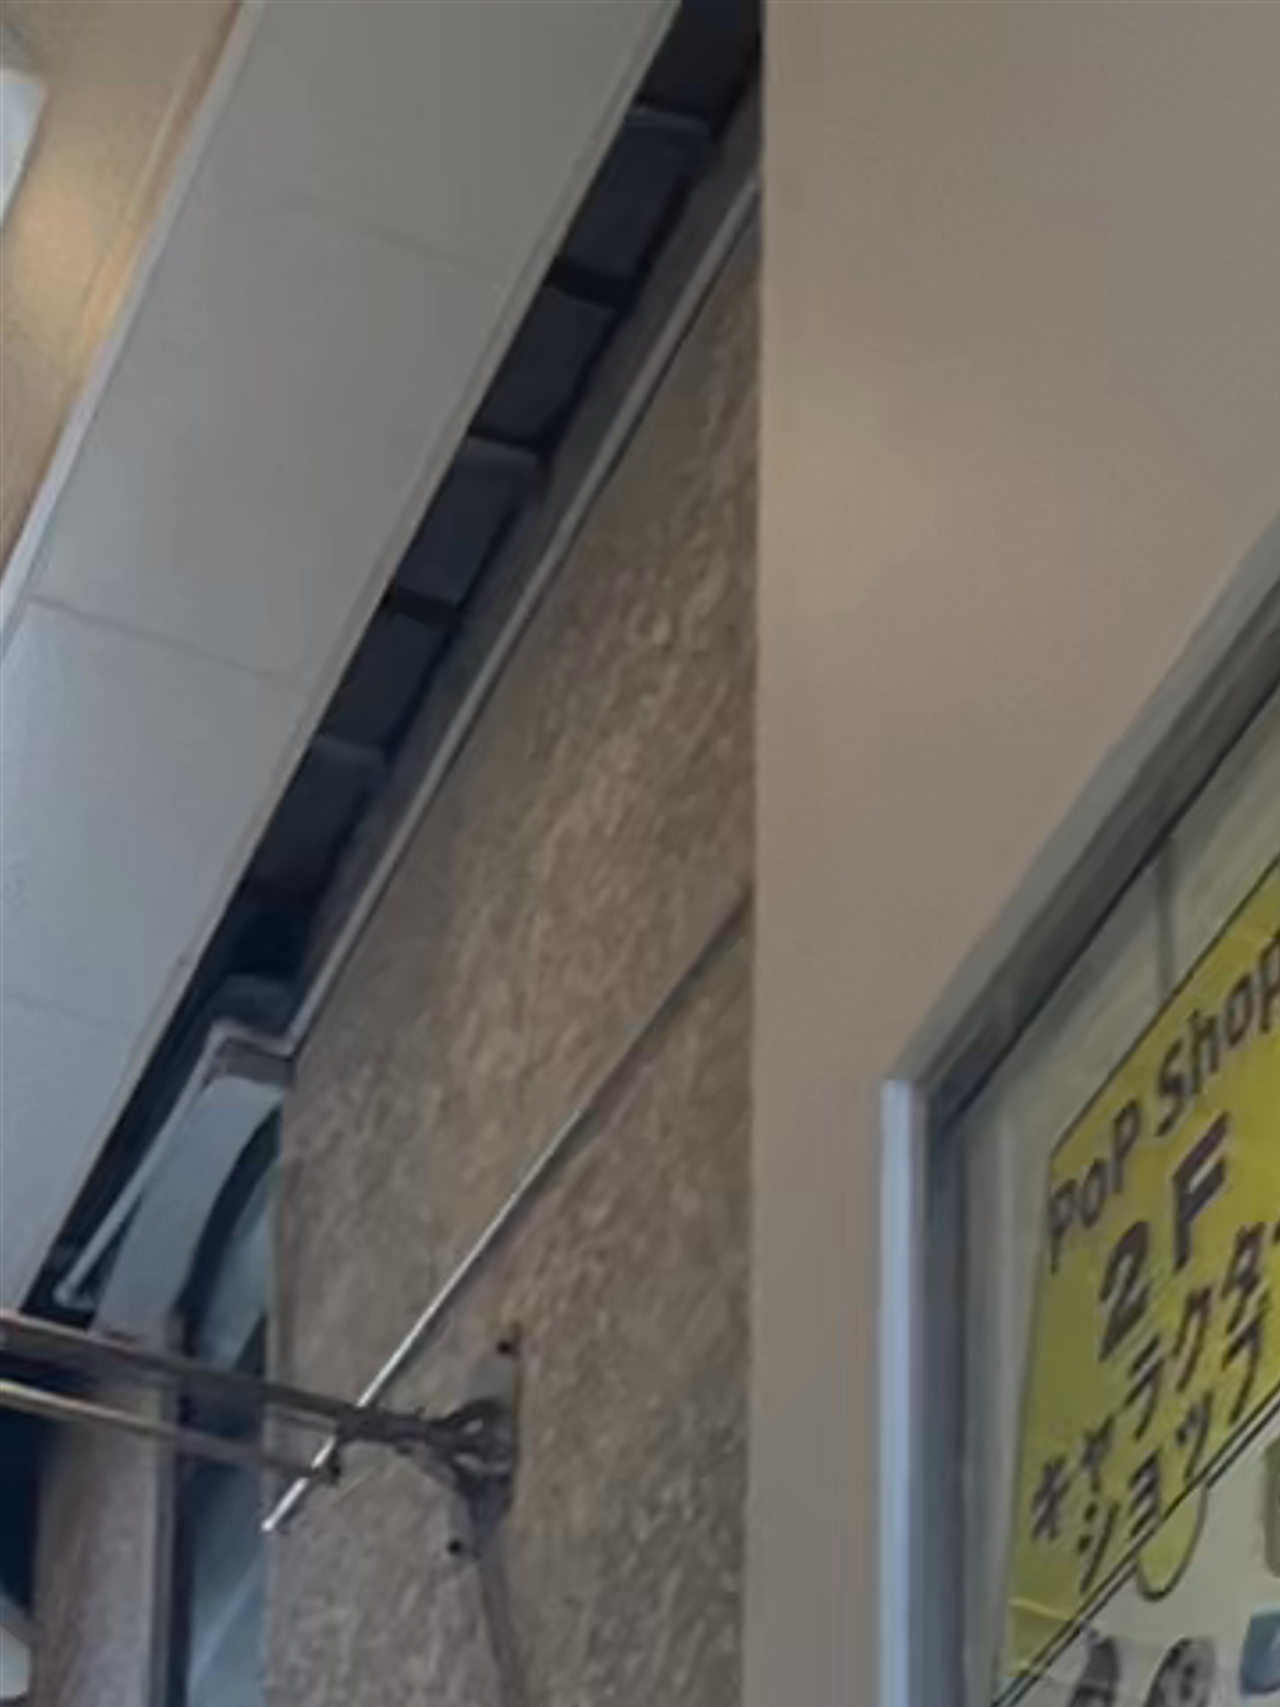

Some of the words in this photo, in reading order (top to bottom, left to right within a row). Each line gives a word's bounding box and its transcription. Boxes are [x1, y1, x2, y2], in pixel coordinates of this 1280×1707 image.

[1099, 1112, 1230, 1362] 2F
[1077, 1293, 1269, 1594] ショップ
